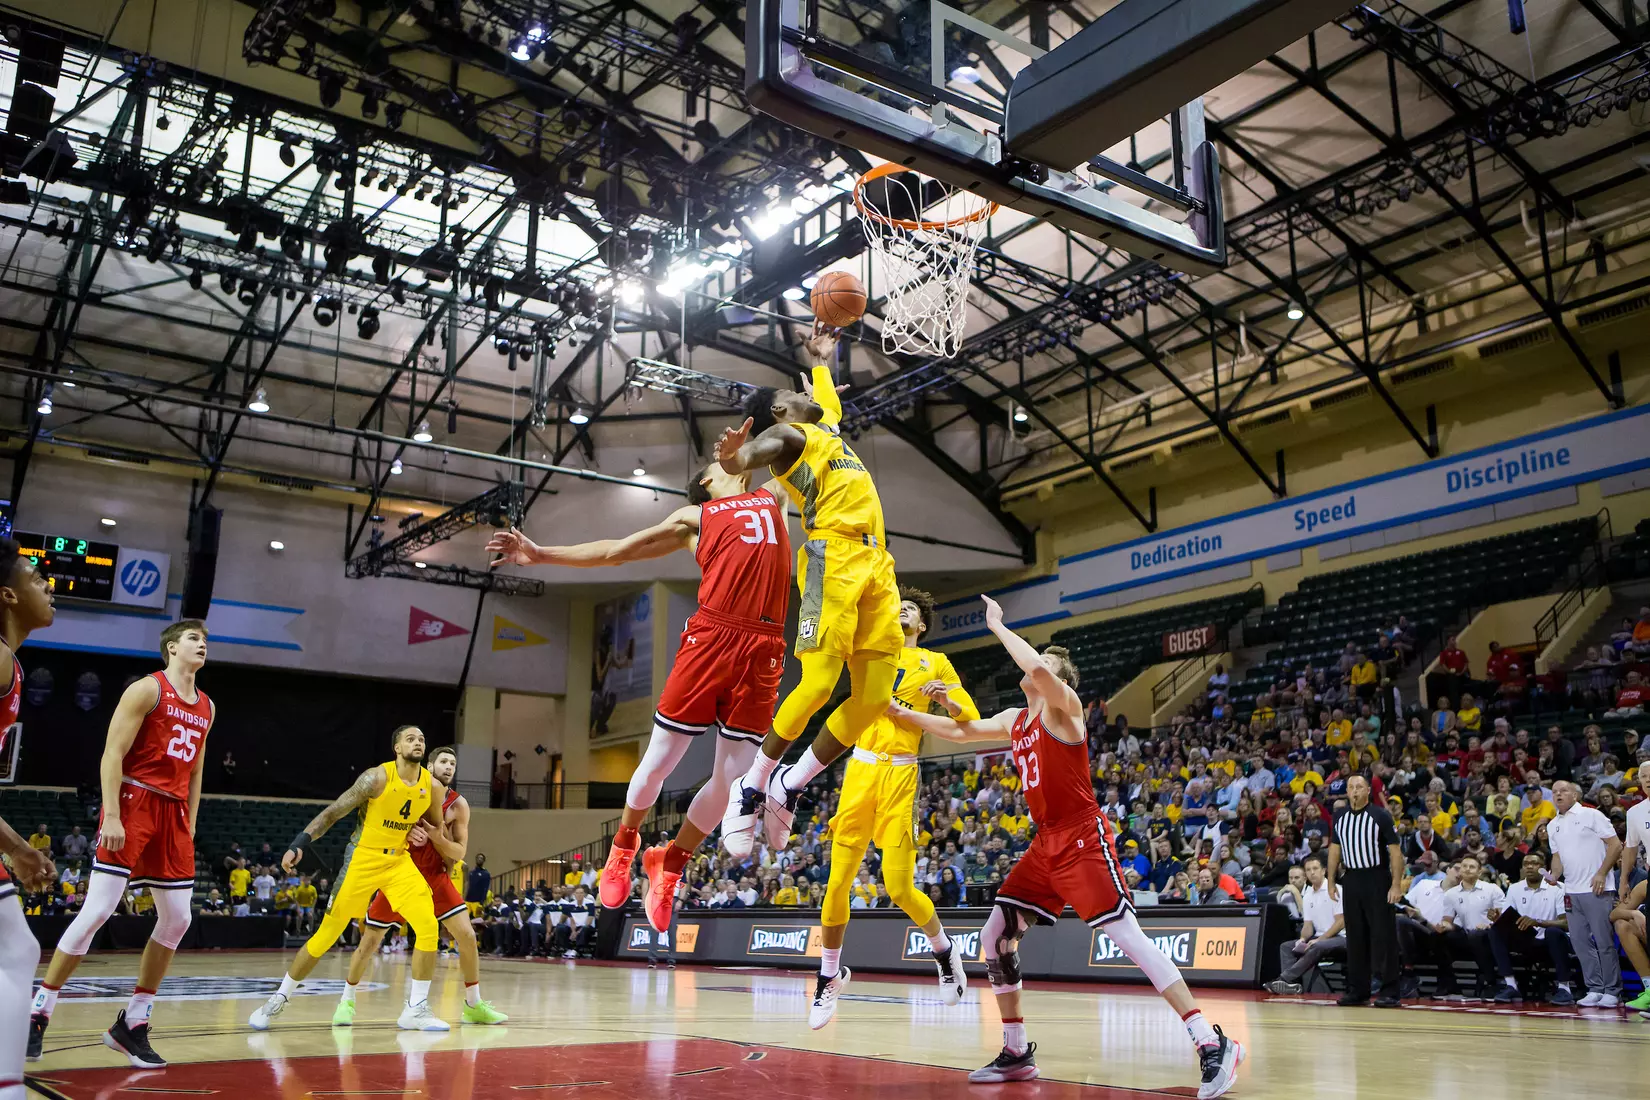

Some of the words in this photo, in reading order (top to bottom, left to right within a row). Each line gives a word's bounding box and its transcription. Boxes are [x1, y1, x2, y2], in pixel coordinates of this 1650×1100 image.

[1446, 447, 1570, 493] Discipline
[707, 497, 777, 514] DAVIDSON
[1294, 495, 1356, 532] Speed
[733, 509, 778, 545] 31
[1130, 534, 1222, 570] Dedication
[125, 560, 160, 597] hp
[941, 610, 986, 631] Succes
[1169, 627, 1209, 654] GUEST
[167, 704, 209, 729] DAVIDSON
[167, 723, 202, 763] 25
[1018, 751, 1040, 791] 13
[399, 799, 413, 820] 4
[1076, 839, 1084, 849] D
[751, 929, 808, 952] SPALDING
[1201, 940, 1239, 957] .COM
